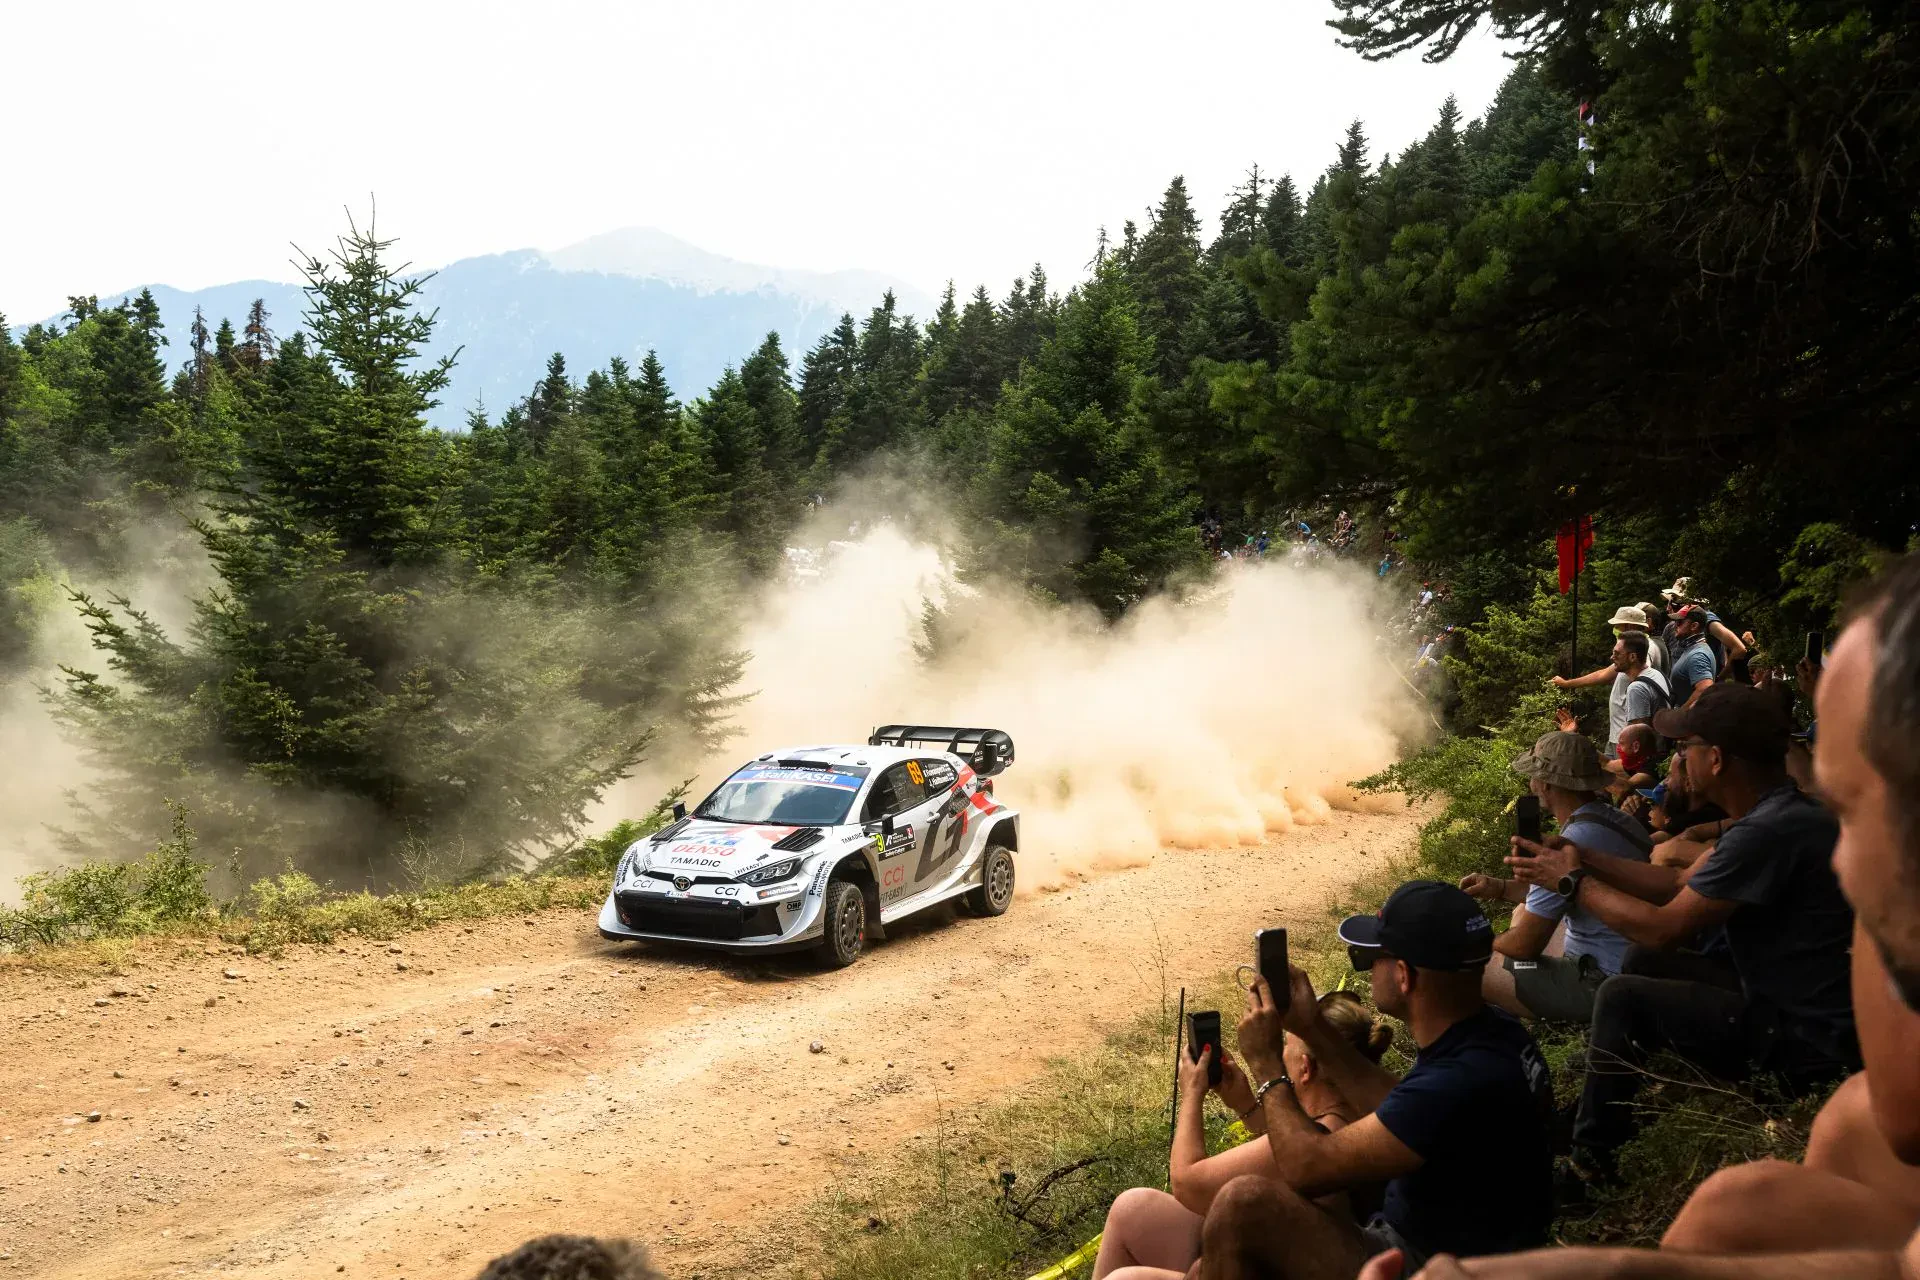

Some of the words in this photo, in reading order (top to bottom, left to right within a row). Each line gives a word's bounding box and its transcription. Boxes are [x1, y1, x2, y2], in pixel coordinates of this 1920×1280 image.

[906, 760, 924, 784] 69
[841, 832, 863, 844] TAMADIC
[672, 844, 736, 856] DENSO
[670, 857, 721, 867] TAMADIC
[786, 901, 801, 911] OMP
